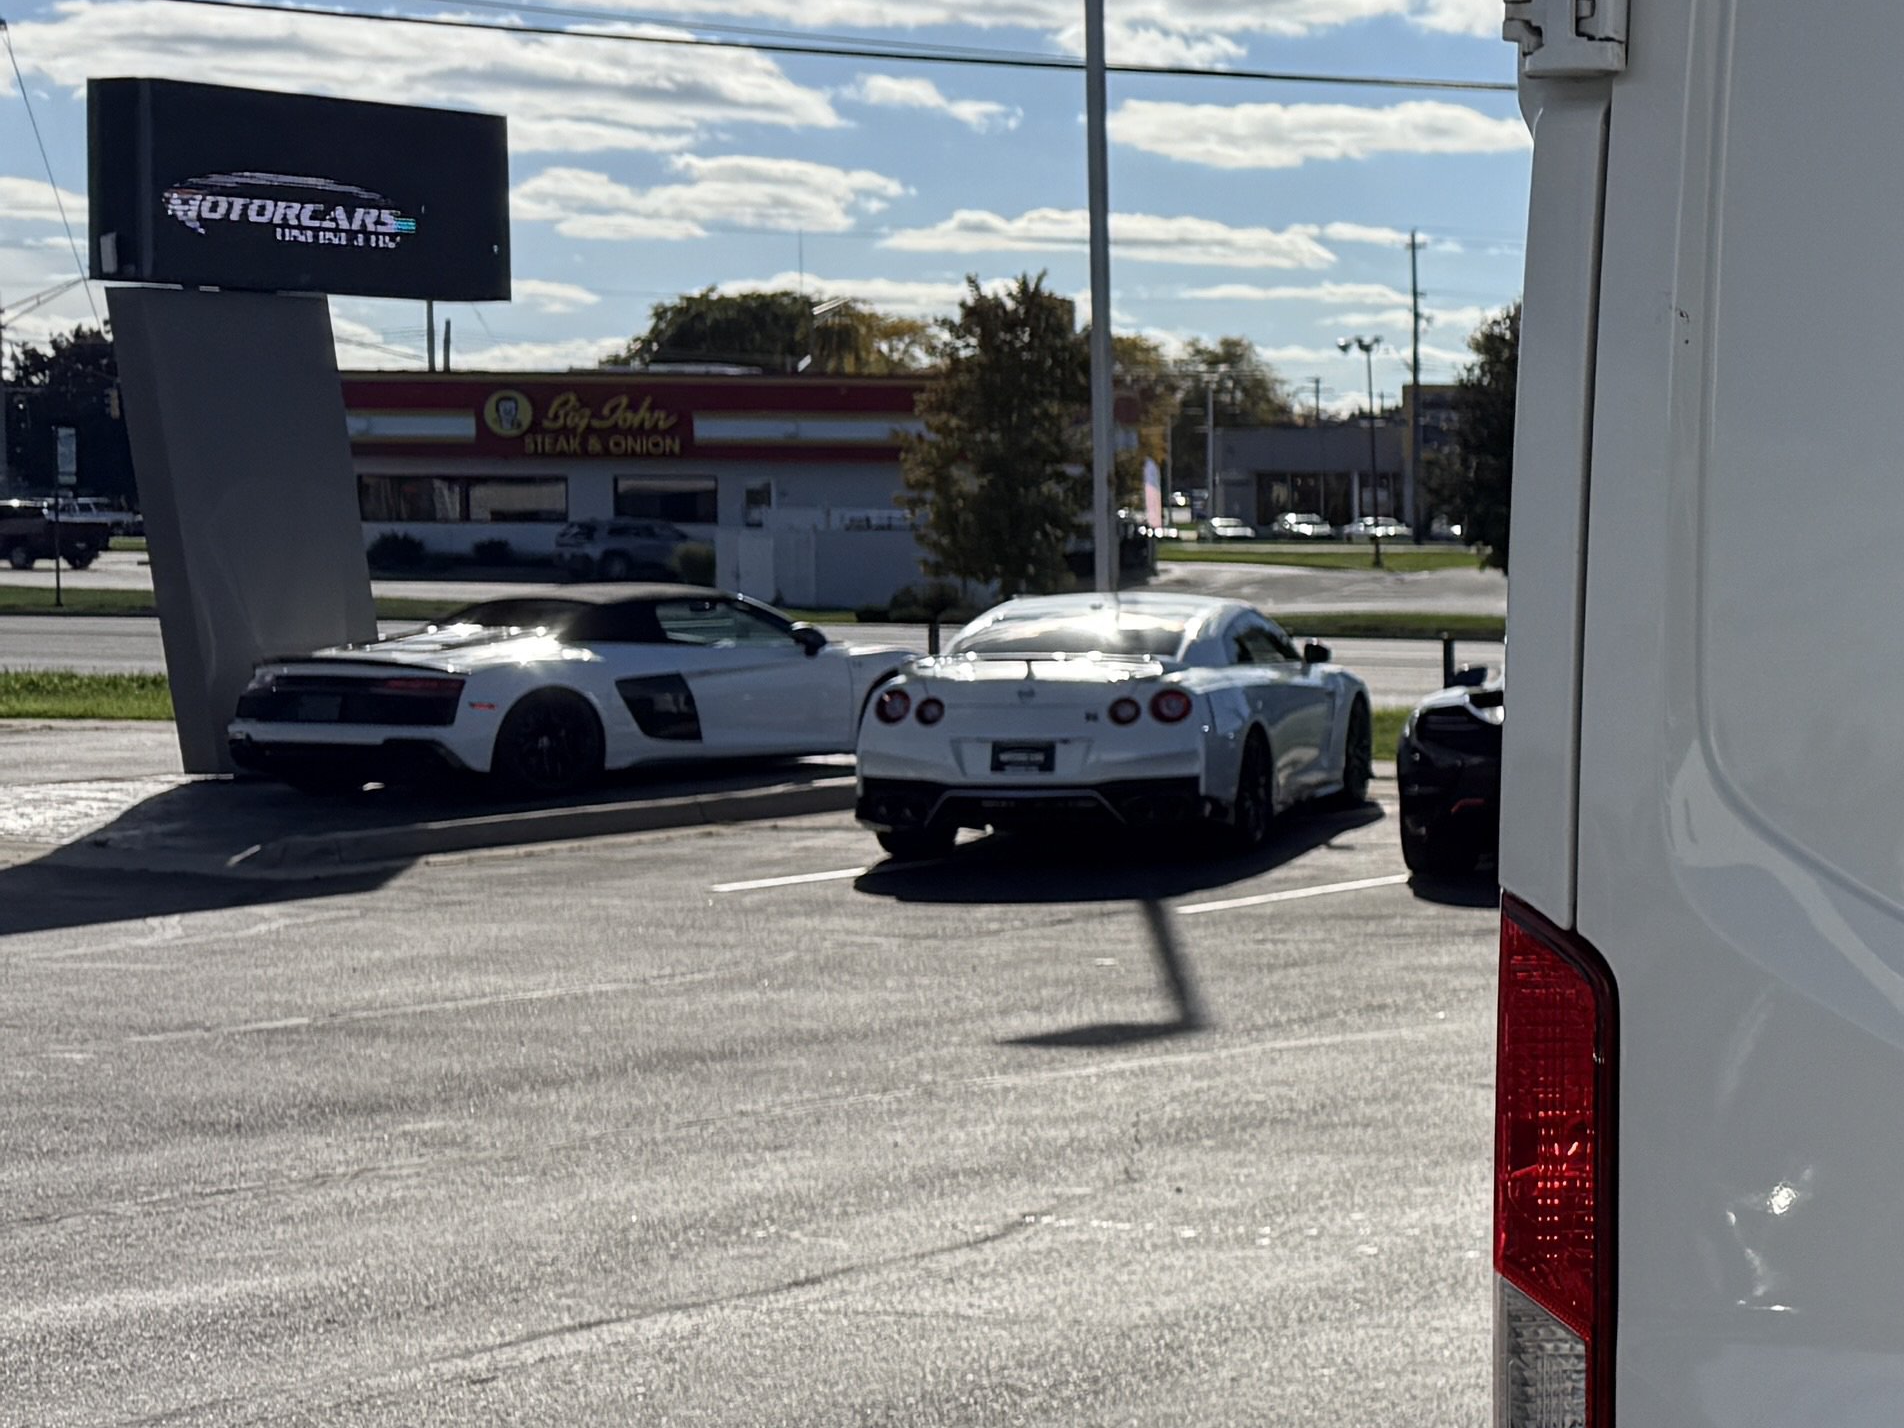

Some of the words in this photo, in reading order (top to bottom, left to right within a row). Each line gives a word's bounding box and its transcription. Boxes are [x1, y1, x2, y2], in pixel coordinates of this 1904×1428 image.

[590, 394, 678, 431] John
[524, 433, 581, 456] STEAK
[609, 434, 681, 456] ONION
